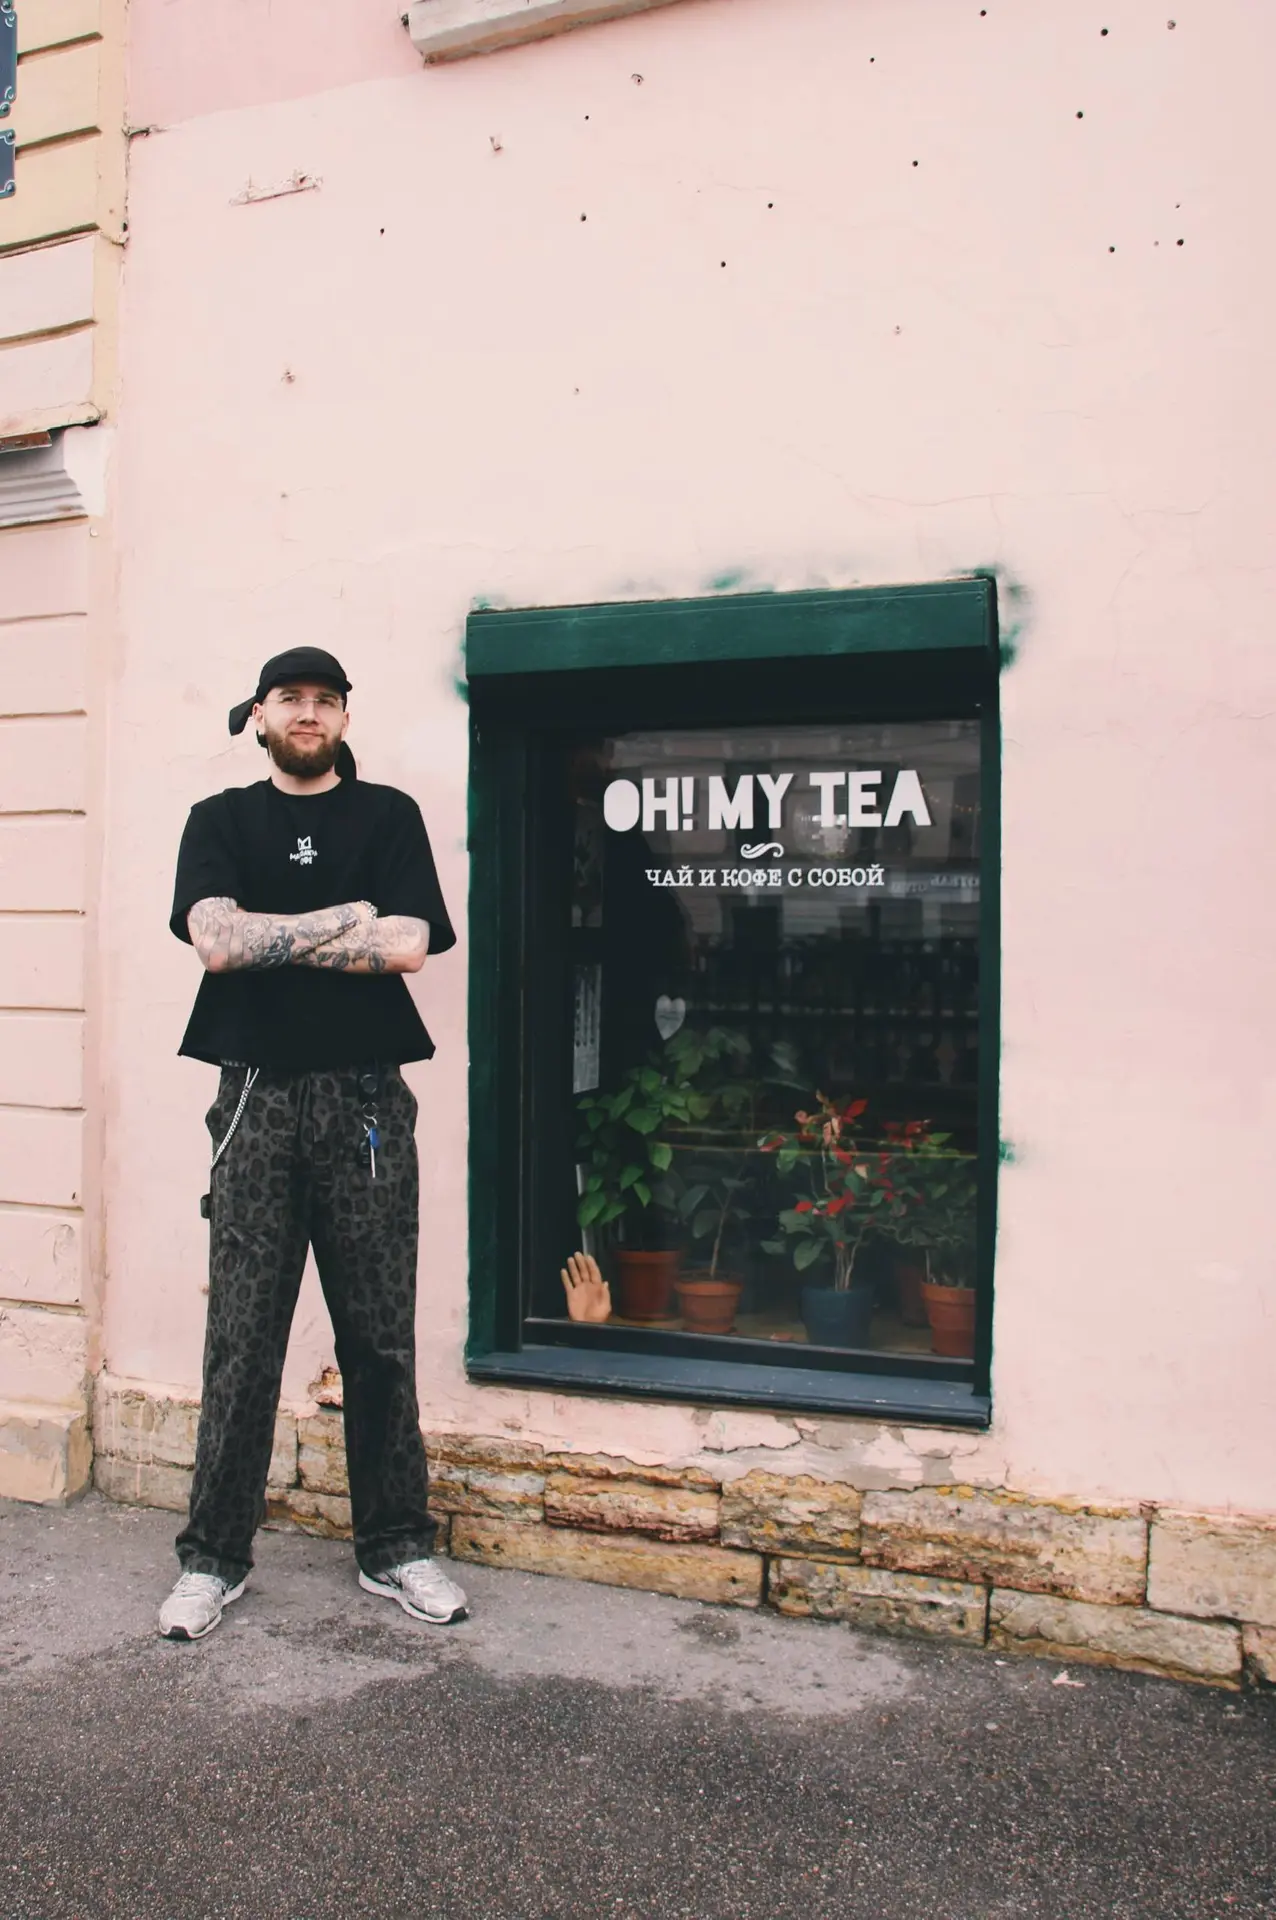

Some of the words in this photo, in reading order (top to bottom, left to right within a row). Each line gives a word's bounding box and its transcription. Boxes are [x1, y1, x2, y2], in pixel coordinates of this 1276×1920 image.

[604, 776, 694, 832] OH!
[708, 773, 794, 831] MY
[809, 770, 932, 828] TEA
[645, 864, 694, 887] ЧАЙ
[698, 868, 716, 887] И
[720, 867, 782, 887] КОФЕ
[787, 867, 802, 887] С
[807, 863, 885, 887] СОБОЙ
